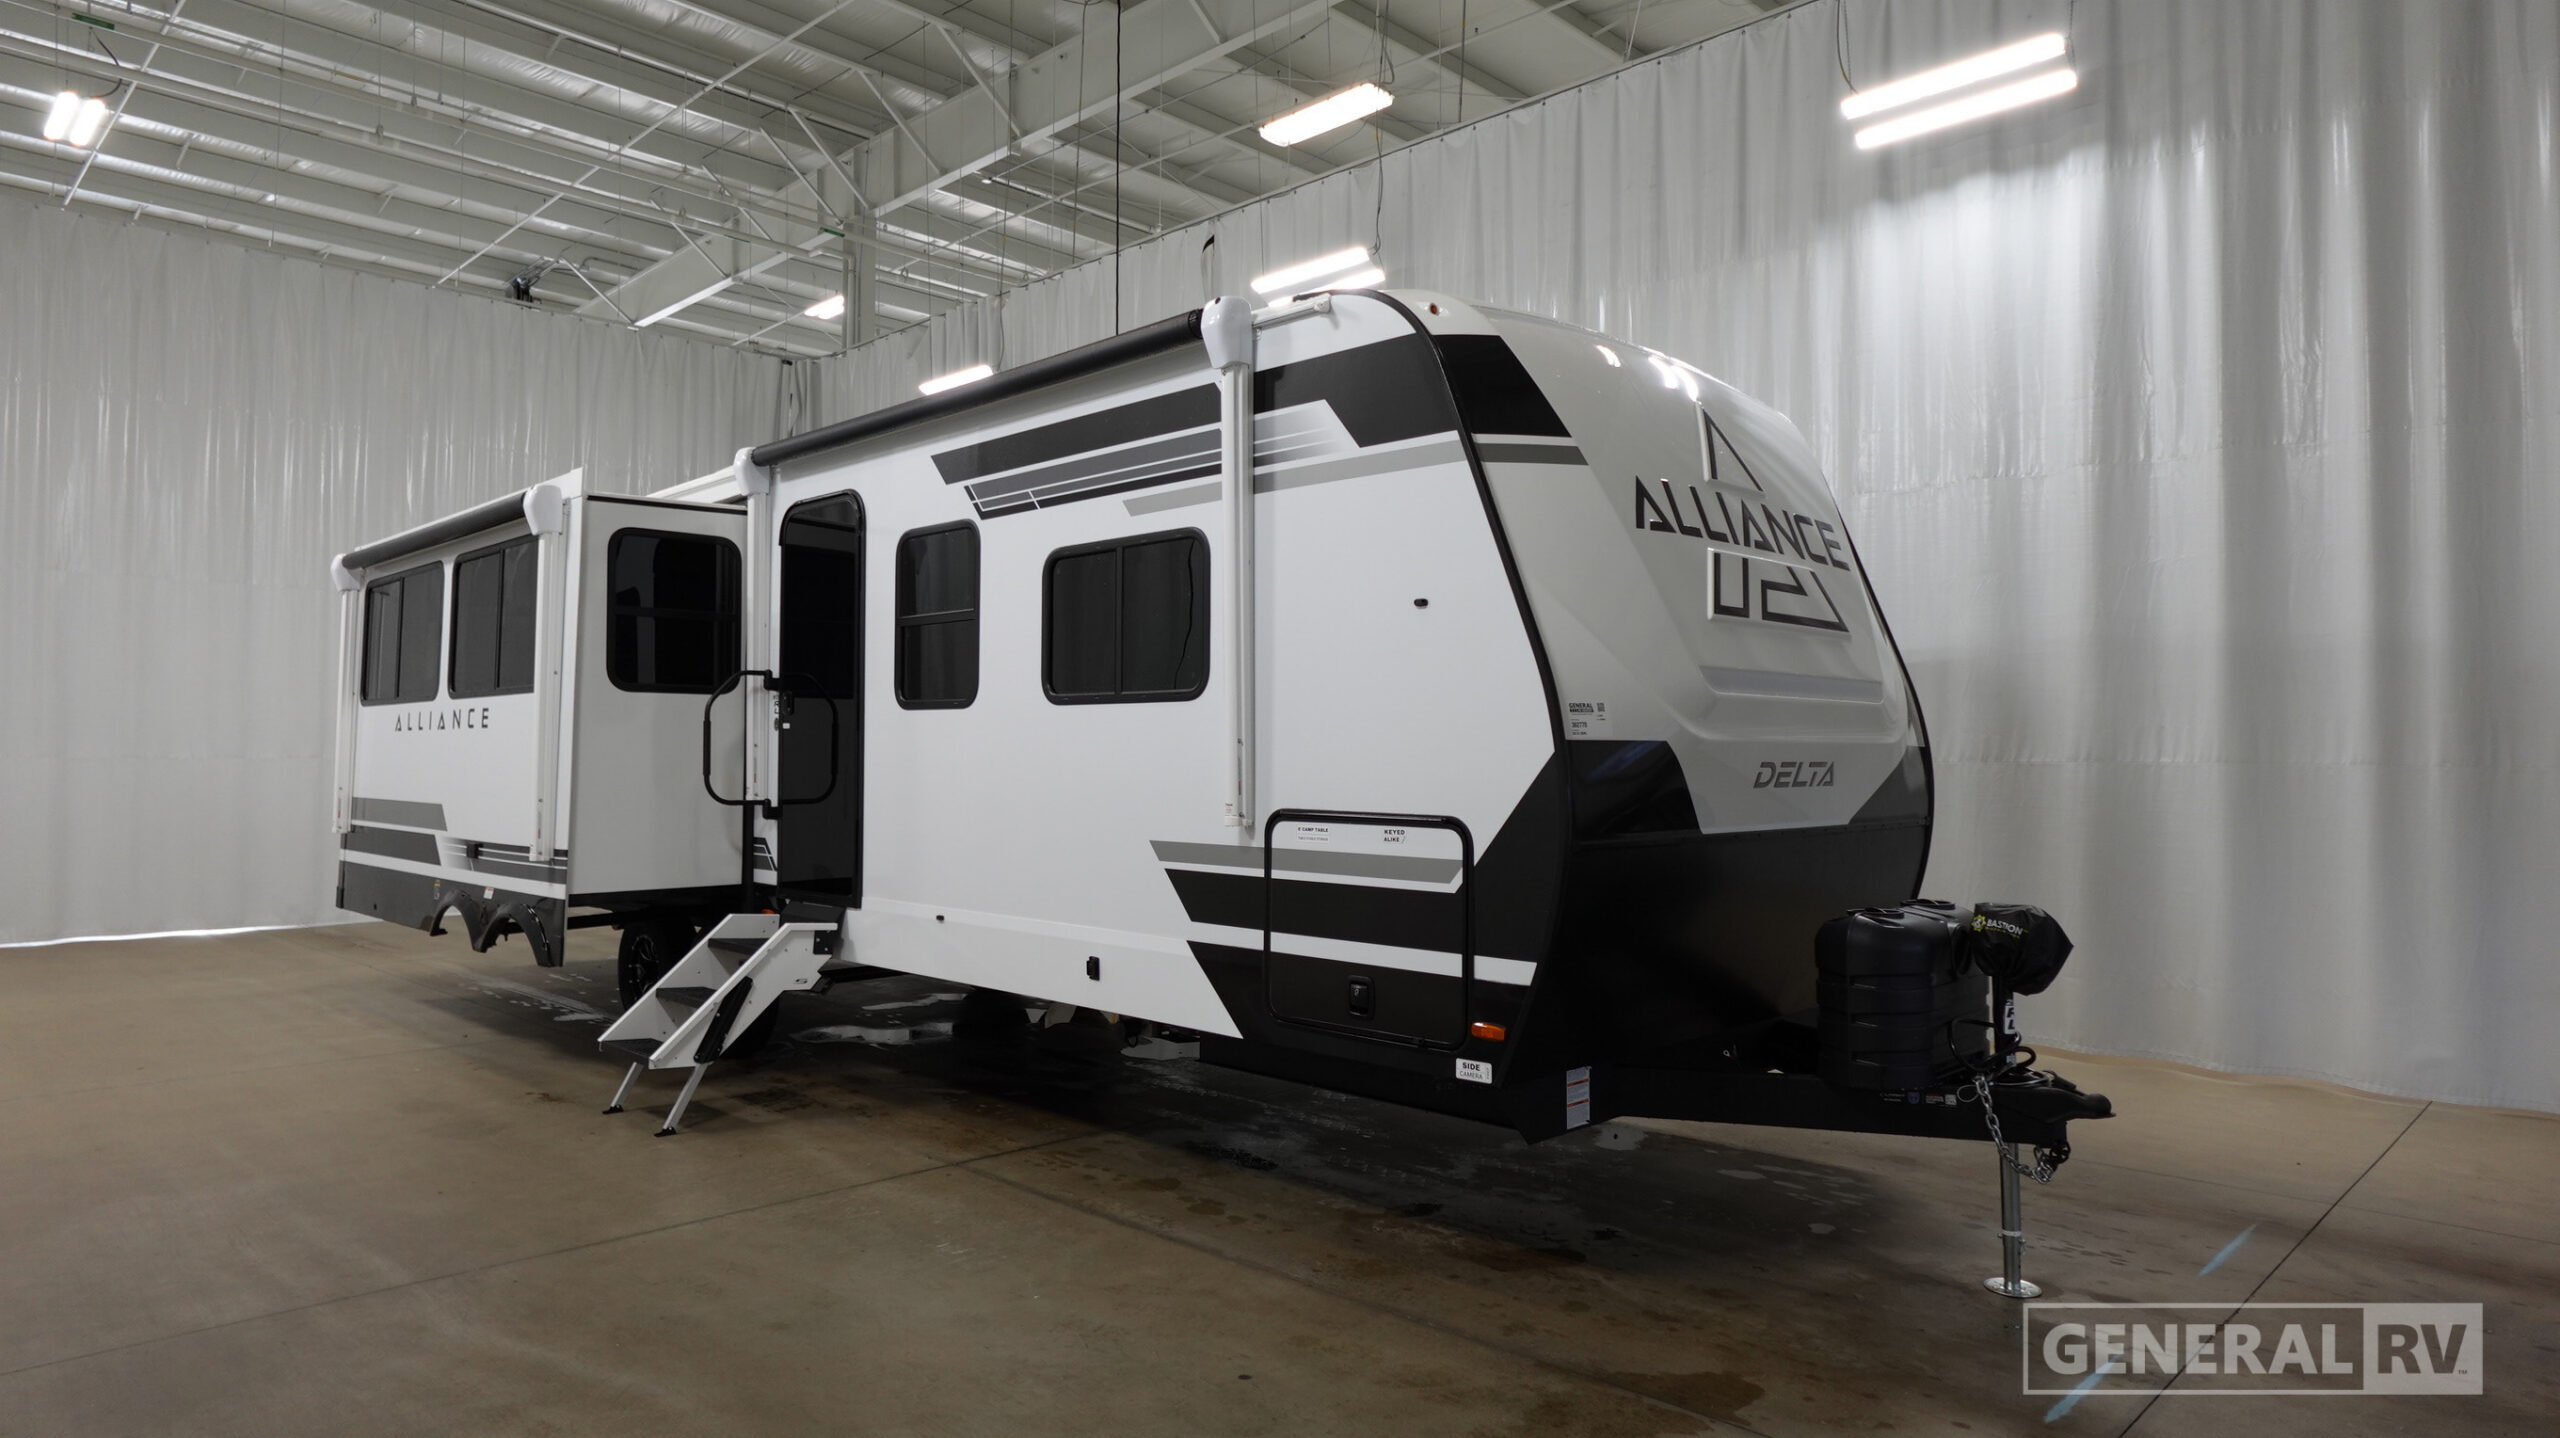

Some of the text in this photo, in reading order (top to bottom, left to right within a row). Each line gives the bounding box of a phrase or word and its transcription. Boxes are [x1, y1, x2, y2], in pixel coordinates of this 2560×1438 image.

[1635, 475, 1851, 571] ALLIANCE
[394, 706, 490, 732] ALLIANCE
[1753, 761, 1835, 789] DELTA
[1459, 1070, 1483, 1080] CAMERA
[1462, 1062, 1480, 1072] SIDE
